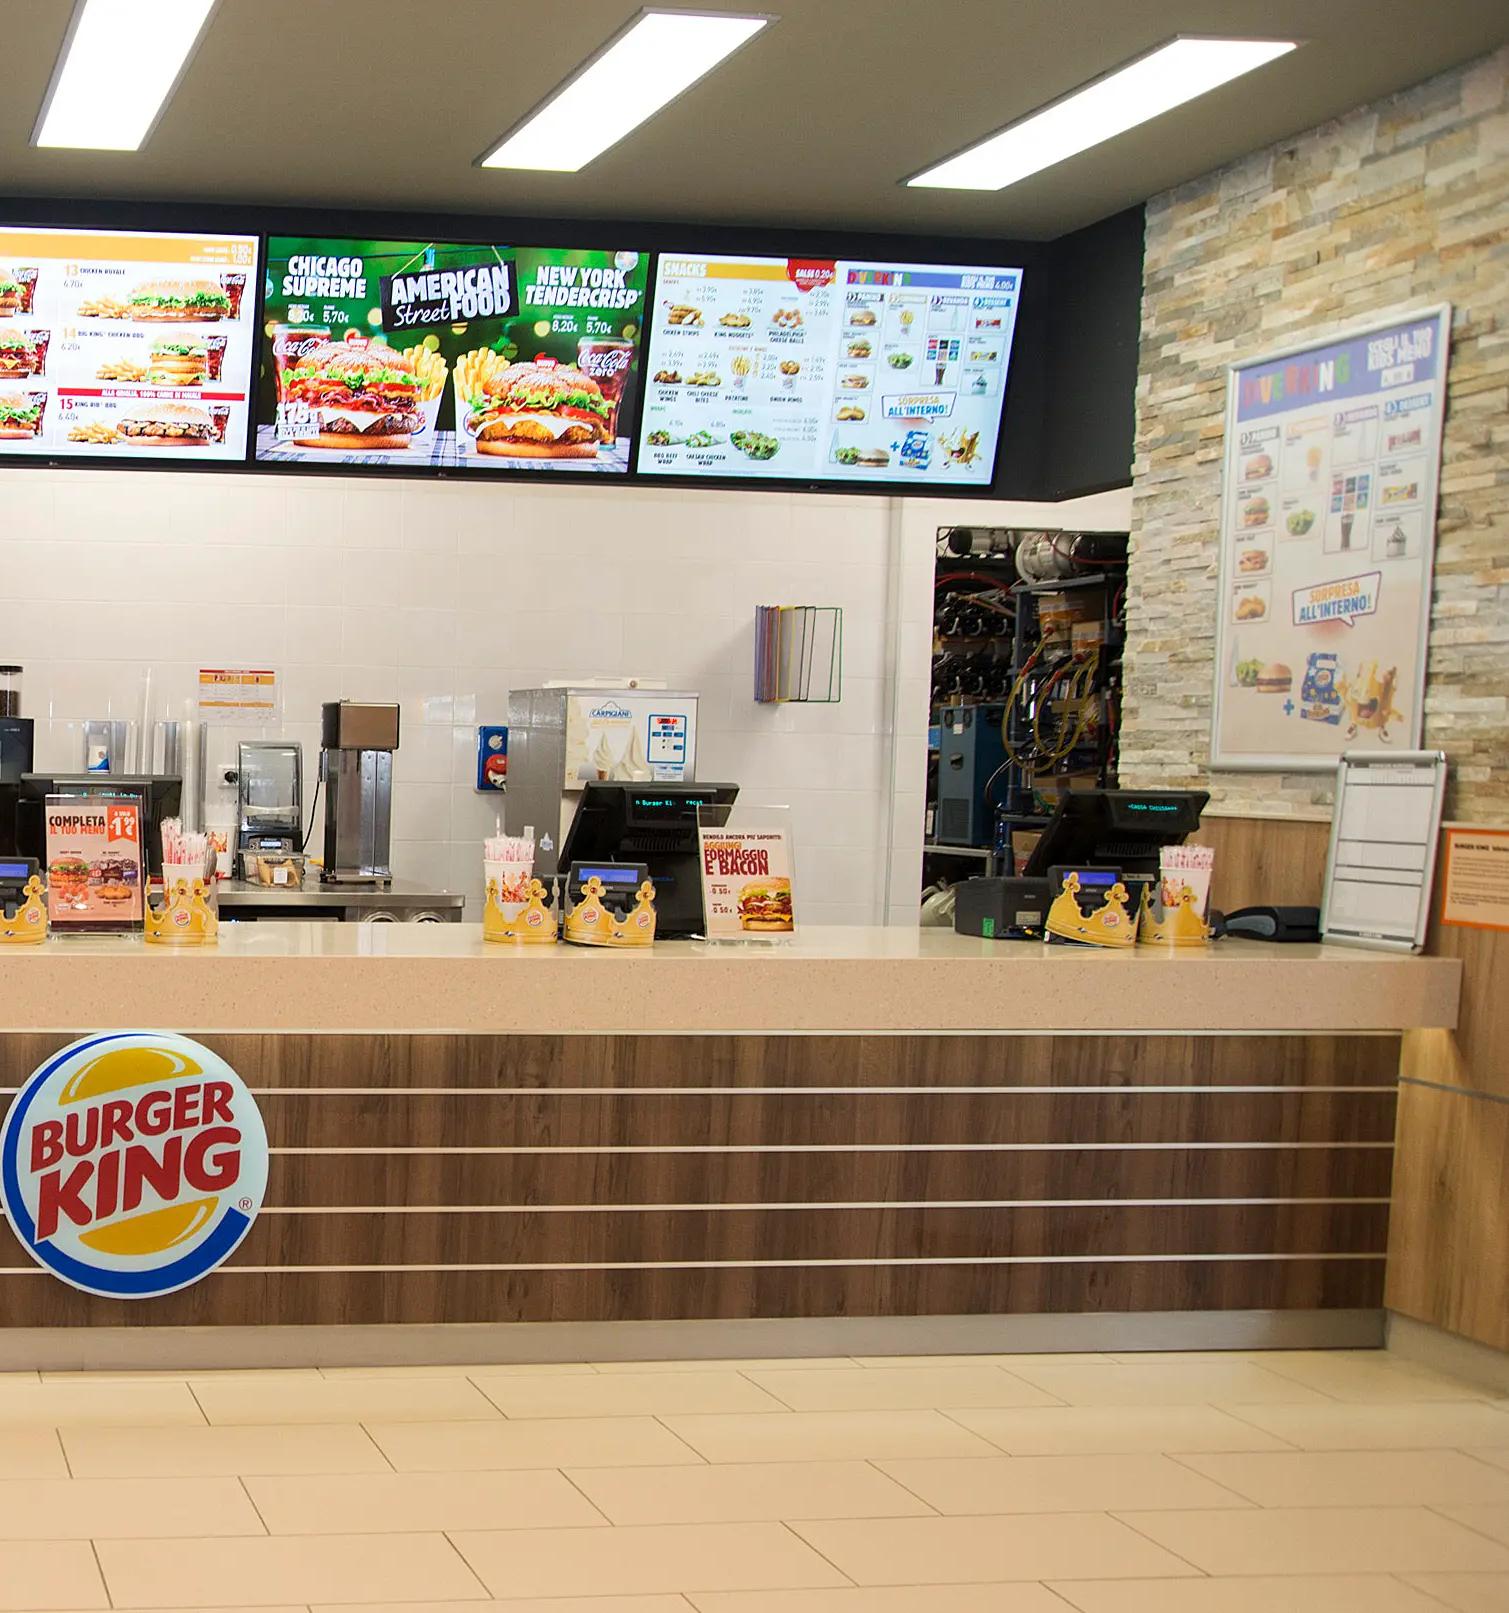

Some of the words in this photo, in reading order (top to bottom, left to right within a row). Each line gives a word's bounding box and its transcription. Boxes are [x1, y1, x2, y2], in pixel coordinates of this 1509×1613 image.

[66, 264, 78, 277] 13
[288, 255, 363, 278] CHICAGO
[664, 261, 708, 277] SNACKS
[391, 264, 510, 306] AMERICAN
[536, 266, 578, 287] NEW
[580, 266, 627, 289] YORK
[282, 276, 367, 299] SUPREME
[525, 285, 639, 309] TENDERCRISP
[393, 299, 452, 327] Street
[449, 287, 511, 321] FOOD
[63, 327, 76, 339] 14
[588, 366, 614, 378] zero
[1243, 353, 1350, 408] DIVERKING
[60, 398, 73, 410] 15
[888, 404, 949, 416] ALL'INTERNO!
[1309, 581, 1360, 604] SORPRESA
[1298, 594, 1372, 622] ALL'INTERNO!
[592, 709, 630, 718] CARPIGIANI
[49, 816, 106, 827] COMPLETA
[50, 826, 58, 834] IL
[61, 826, 78, 834] TUO
[704, 849, 768, 861] FORMAGGIO
[705, 860, 714, 876] E
[719, 860, 769, 876] BACON
[30, 1081, 235, 1174] BURGER
[36, 1126, 242, 1242] KING
